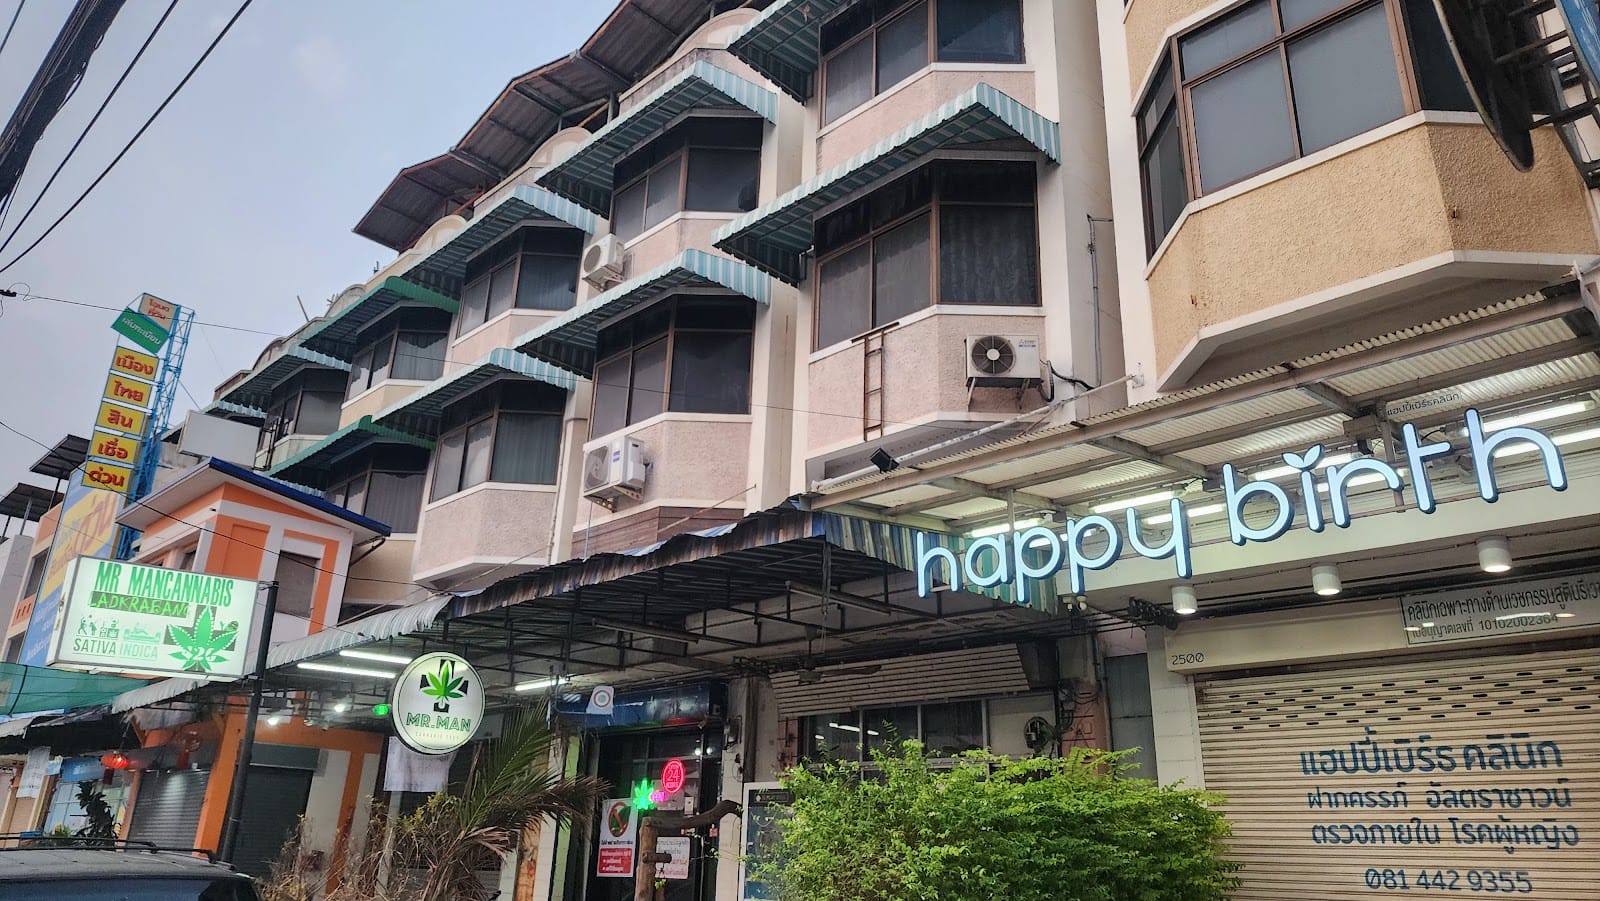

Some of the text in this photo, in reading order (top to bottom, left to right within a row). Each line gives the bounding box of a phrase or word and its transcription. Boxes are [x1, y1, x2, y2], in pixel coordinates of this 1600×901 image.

[116, 354, 154, 376] เมือง
[113, 380, 144, 402] ไทย
[107, 408, 133, 429] สิน
[97, 437, 128, 460] เชื่อ
[88, 466, 125, 487] ด่วน
[916, 407, 1568, 604] happy birth
[94, 561, 234, 608] MR MANCANNABIS
[1407, 579, 1600, 622] คลินิกเฉพาะทางด้านเวชกรรมสูตินรีเว
[73, 638, 158, 660] SATIVA INDICA
[1171, 652, 1205, 665] 2500
[406, 712, 471, 732] MR.MAN
[1463, 732, 1563, 772] คลินิก
[1307, 781, 1409, 809] ฝากครรภ์
[1312, 815, 1580, 855] ตรวจภายใน โรคผู้หญิง
[1365, 869, 1533, 893] 081 442 9355
